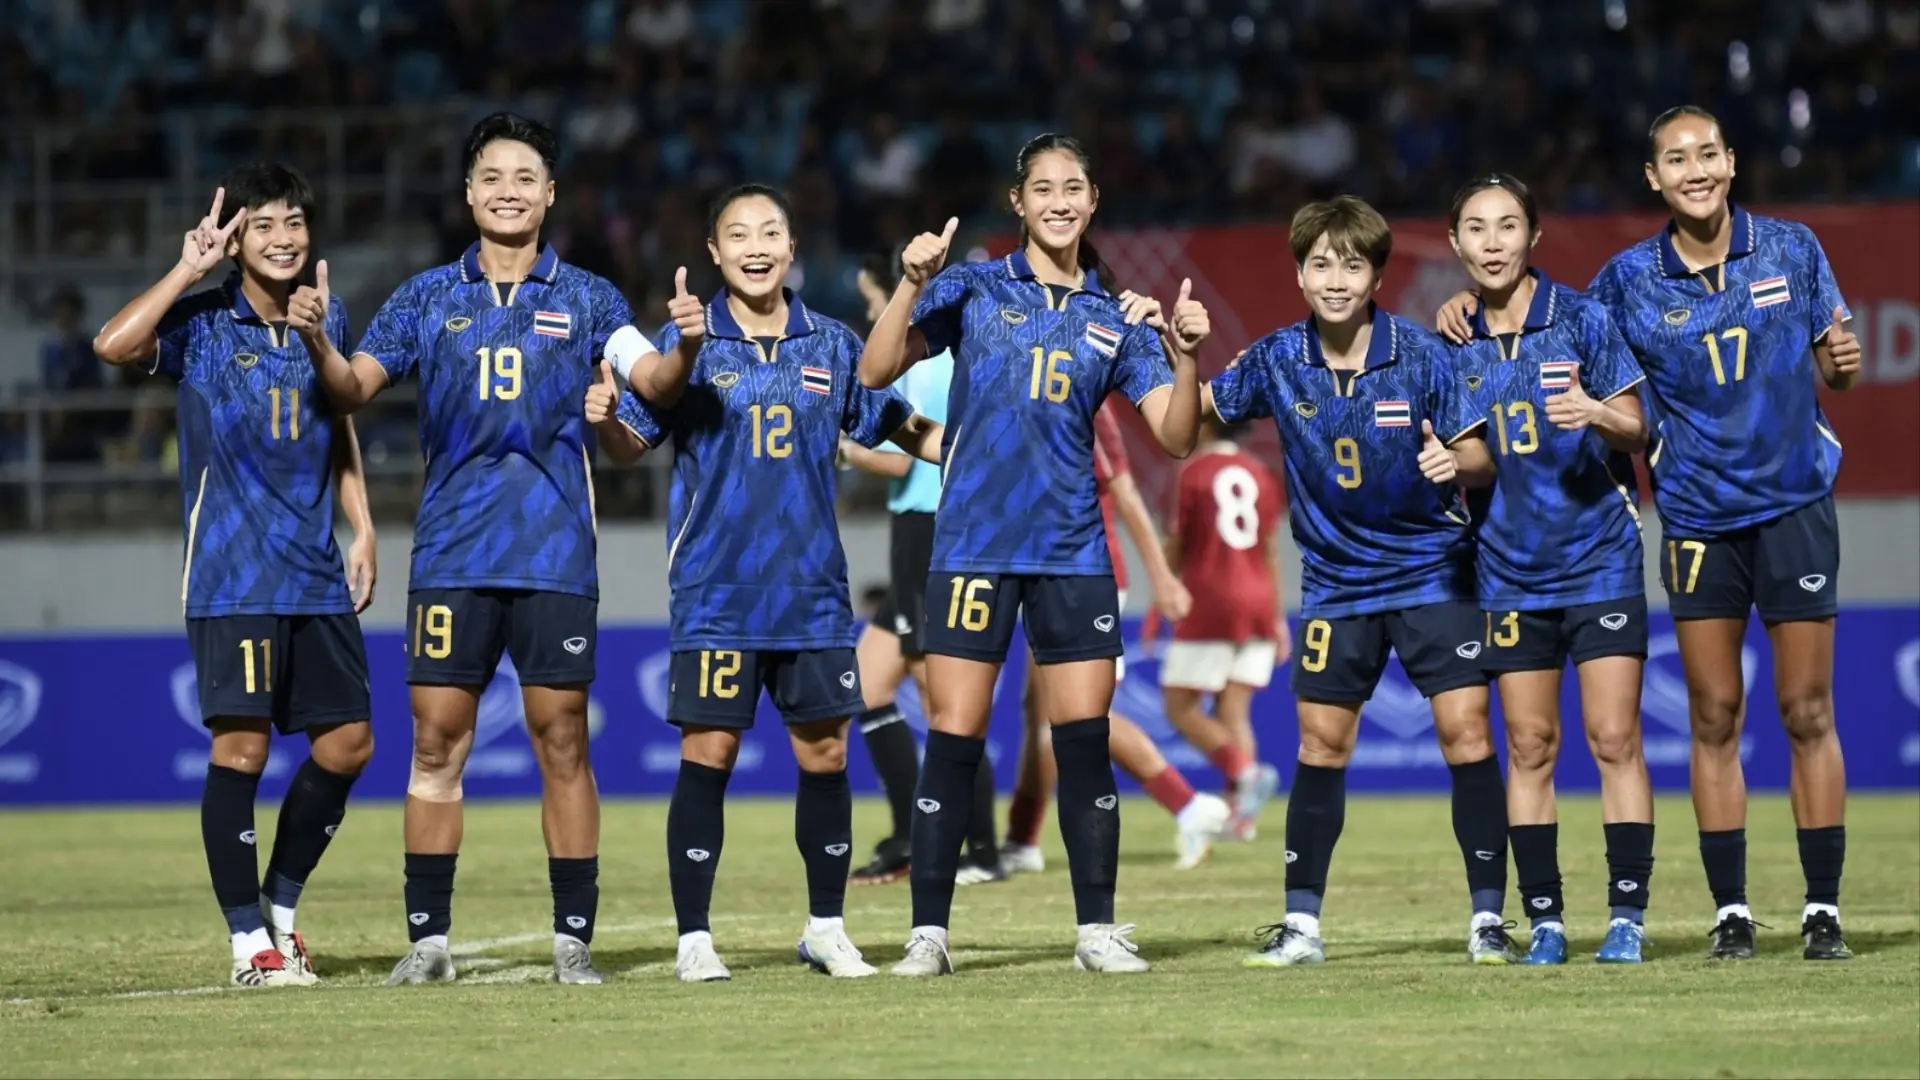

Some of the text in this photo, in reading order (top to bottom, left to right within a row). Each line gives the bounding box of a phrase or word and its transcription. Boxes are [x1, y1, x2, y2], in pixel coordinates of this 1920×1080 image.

[477, 348, 520, 401] 19
[1030, 347, 1071, 403] 16
[1703, 327, 1747, 385] 17
[270, 387, 299, 439] 11
[751, 405, 793, 459] 12
[1491, 400, 1539, 456] 13
[1335, 437, 1362, 489] 9
[1212, 465, 1259, 550] 8
[1668, 540, 1705, 593] 17
[413, 603, 454, 659] 19
[947, 577, 992, 632] 16
[1485, 610, 1520, 648] 13
[239, 638, 272, 694] 11
[1301, 618, 1332, 673] 9
[699, 650, 742, 699] 12
